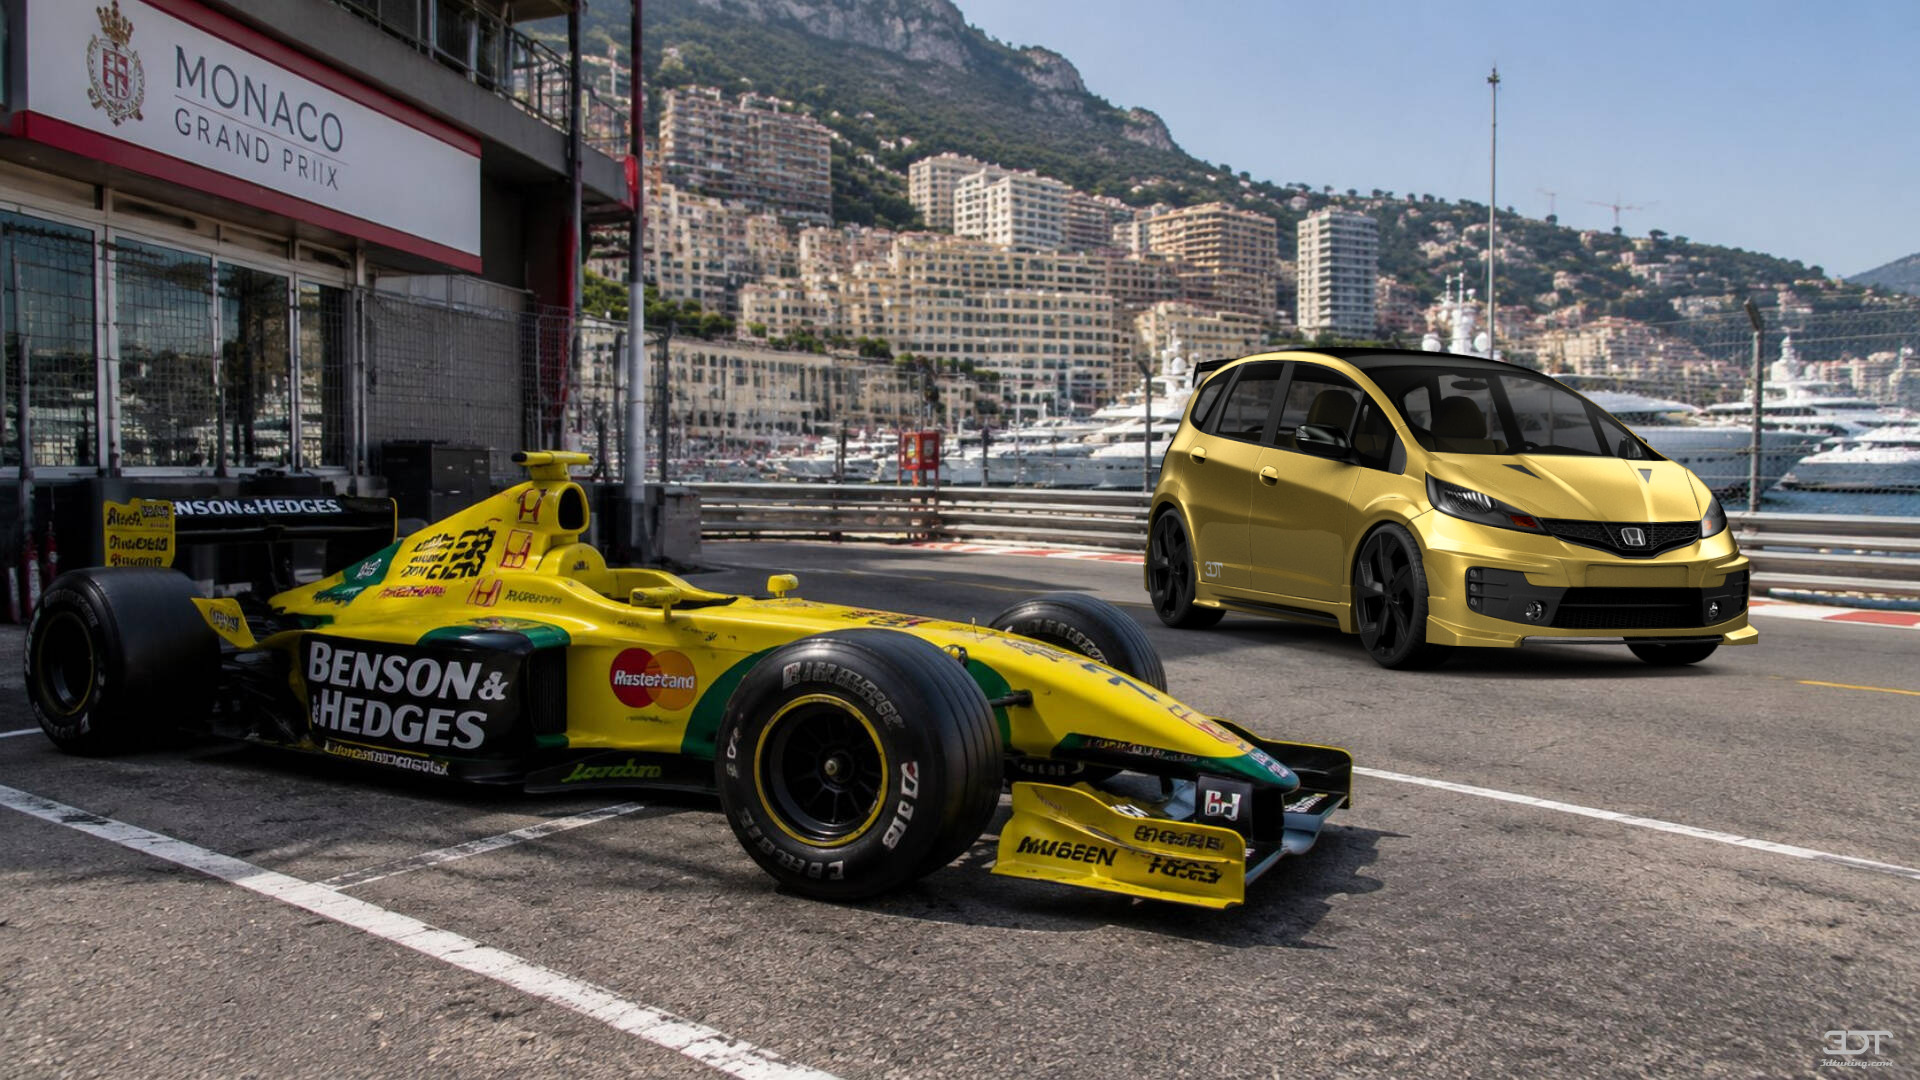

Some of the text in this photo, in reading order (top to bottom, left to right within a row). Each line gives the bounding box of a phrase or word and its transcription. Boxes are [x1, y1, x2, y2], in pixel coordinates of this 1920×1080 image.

[176, 45, 343, 152] MONACO
[174, 108, 338, 190] GRAND PRIIX
